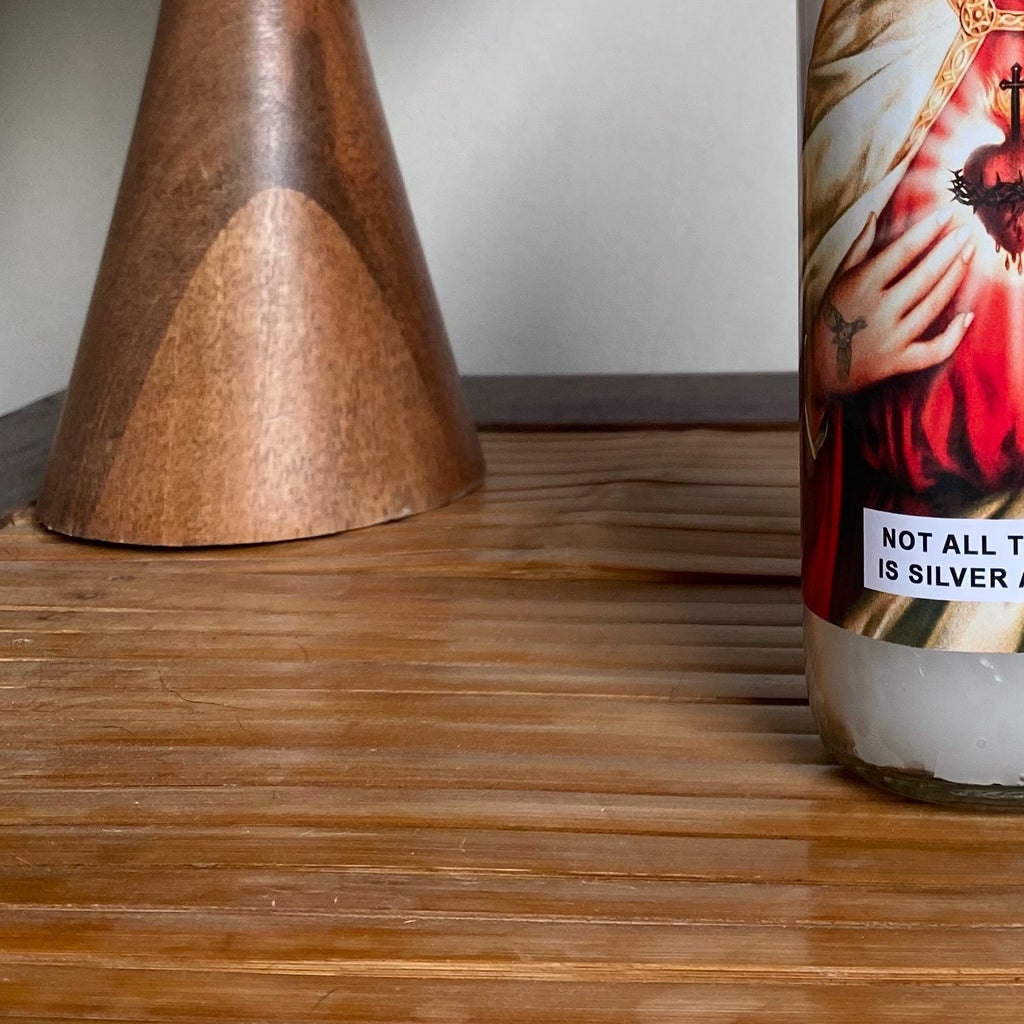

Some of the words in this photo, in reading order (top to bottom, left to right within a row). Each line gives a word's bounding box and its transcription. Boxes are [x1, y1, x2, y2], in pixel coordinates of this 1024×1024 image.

[882, 527, 933, 552] NOT
[942, 534, 996, 555] ALL
[878, 558, 899, 580] IS
[909, 563, 1008, 588] SILVER
